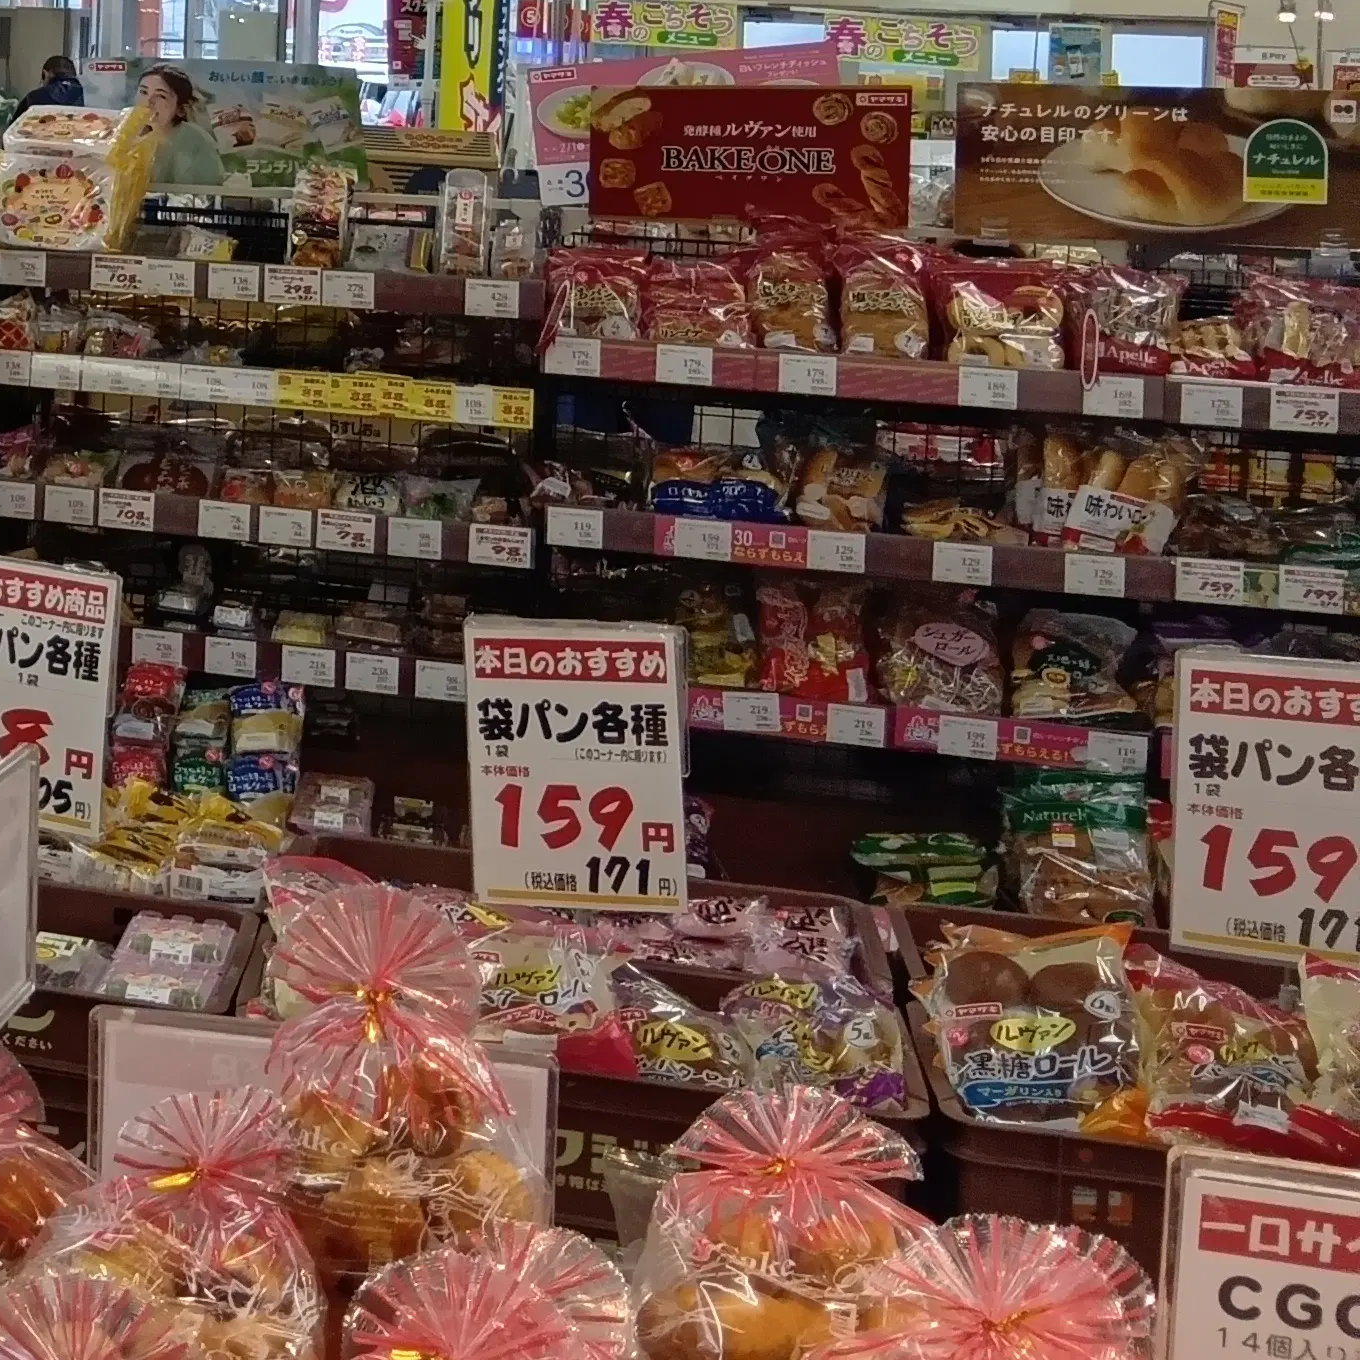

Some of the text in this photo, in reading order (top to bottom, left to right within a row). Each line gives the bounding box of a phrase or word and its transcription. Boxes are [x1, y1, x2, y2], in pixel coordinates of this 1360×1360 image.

[595, 1, 736, 41] 春のごちそう
[665, 33, 713, 45] メニュー
[826, 17, 979, 59] 春のごちそう
[902, 52, 953, 64] メニュー
[870, 94, 905, 104] ヤマザキ
[981, 104, 1188, 122] ナチュレルのグリーンは
[683, 121, 817, 139] 発酵種ルヴァン使用
[981, 125, 1121, 143] 安心の目印です。
[1252, 153, 1320, 167] ナチュレル
[109, 272, 138, 284] 108
[283, 285, 313, 295] 298
[1105, 344, 1158, 365] Apelle
[1293, 409, 1329, 422] 159
[116, 509, 145, 520] 108
[733, 529, 753, 546] 30
[491, 545, 522, 556] 98
[1198, 581, 1234, 594] 159
[1302, 588, 1338, 602] 199
[921, 624, 976, 644] シュガー
[230, 651, 247, 660] 198
[933, 642, 975, 656] ロール
[475, 644, 667, 679] 本日のおすすめ
[749, 704, 770, 716] 219
[477, 698, 669, 747] 袋パン各種
[853, 718, 874, 730] 219
[484, 745, 509, 758] 1袋
[65, 748, 94, 779] 円
[1189, 733, 1360, 791] 袋パン各
[481, 765, 530, 777] 本体価格
[1193, 782, 1221, 797] 1袋
[74, 801, 91, 820] 円)
[494, 783, 675, 853] 159 円
[1186, 803, 1244, 820] 本体価格
[1199, 824, 1358, 904] 159
[586, 855, 650, 895] 171
[494, 966, 561, 987] ルヴァン
[641, 1029, 710, 1052] ルヴァン
[995, 1021, 1072, 1043] ルヴァン
[966, 1045, 1112, 1080] 黒糖ロール
[976, 1084, 1062, 1100] マーガリン入り
